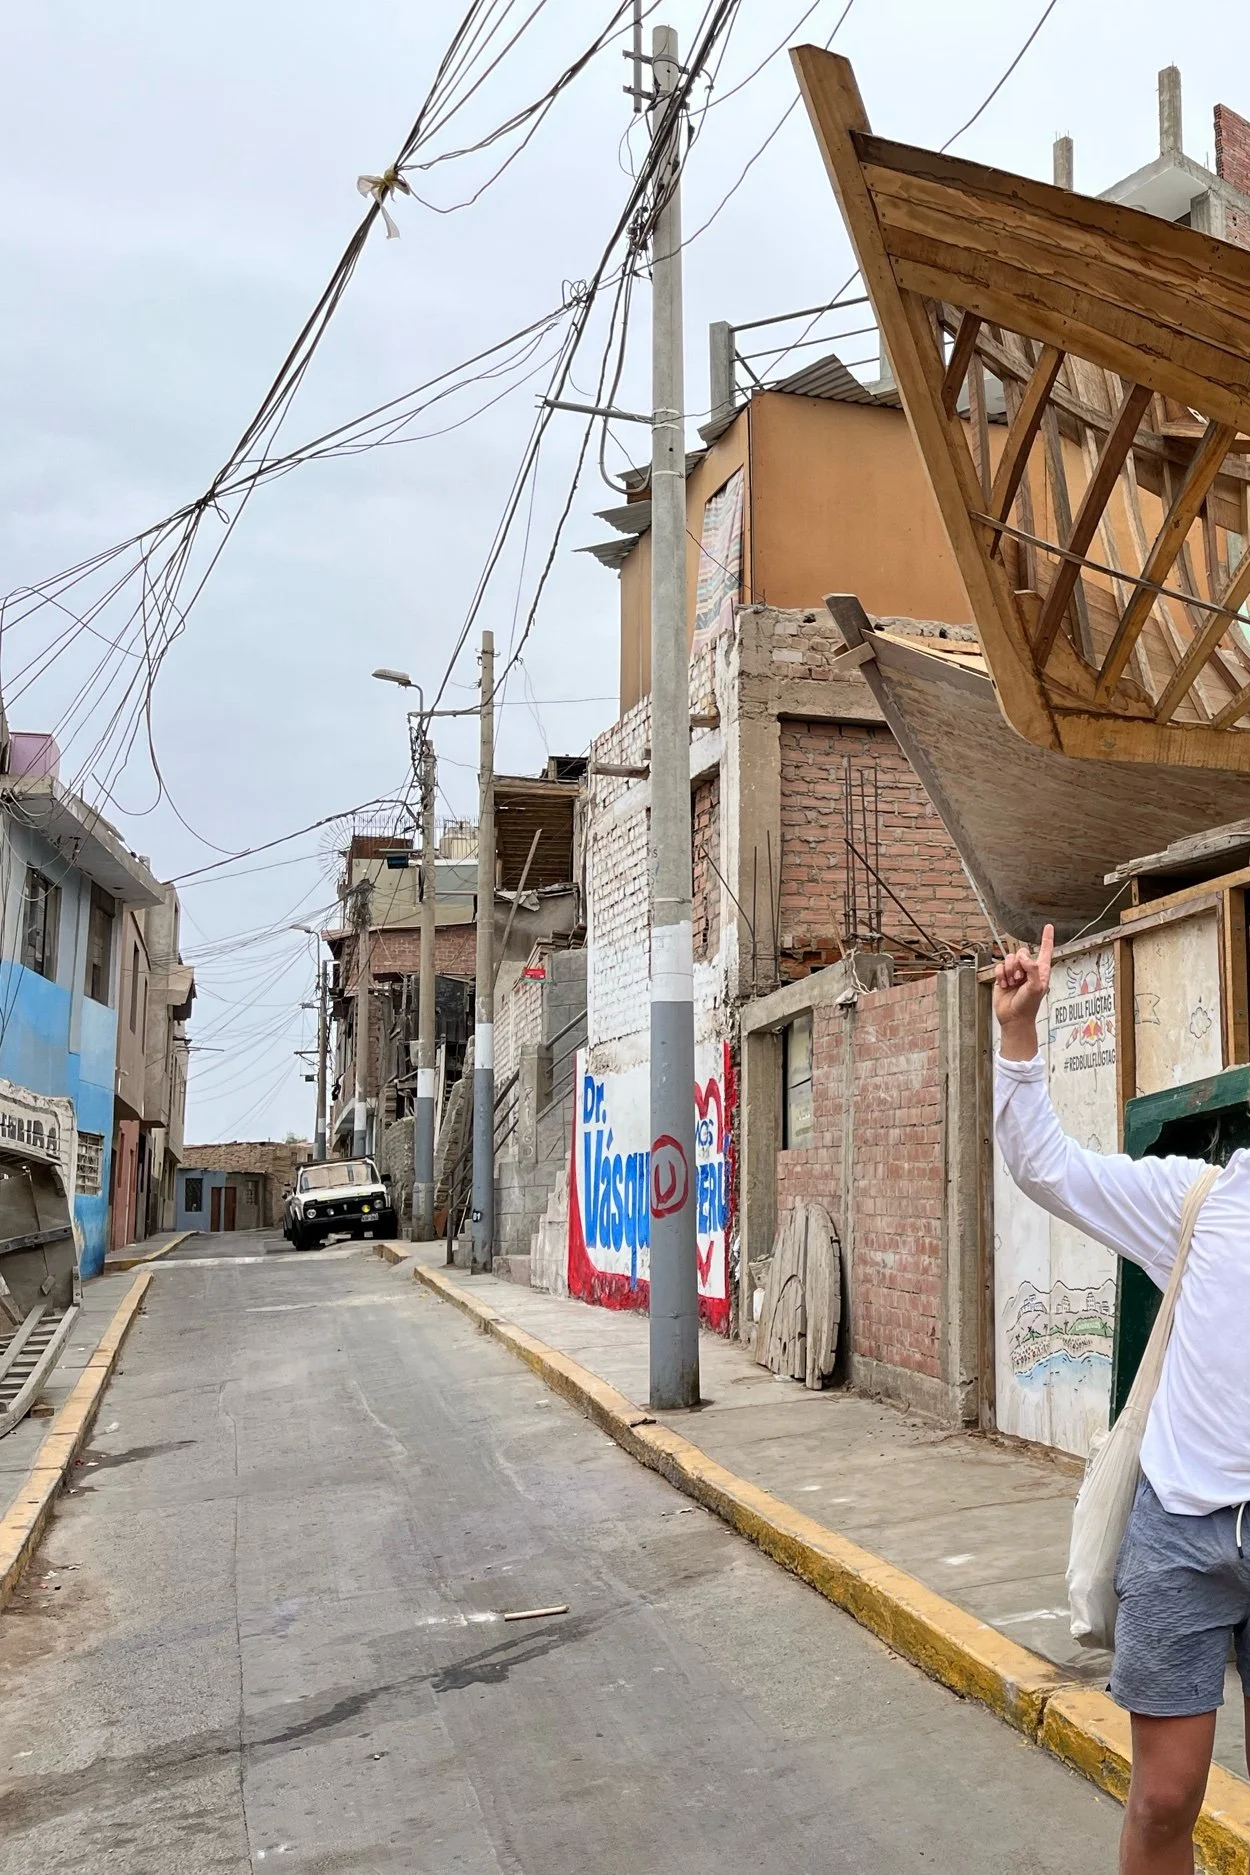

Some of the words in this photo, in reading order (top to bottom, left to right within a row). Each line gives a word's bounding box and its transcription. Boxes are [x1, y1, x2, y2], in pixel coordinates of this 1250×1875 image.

[1055, 1006, 1068, 1024] RED
[1068, 1002, 1084, 1021] BULL
[583, 1075, 607, 1124] Dr.
